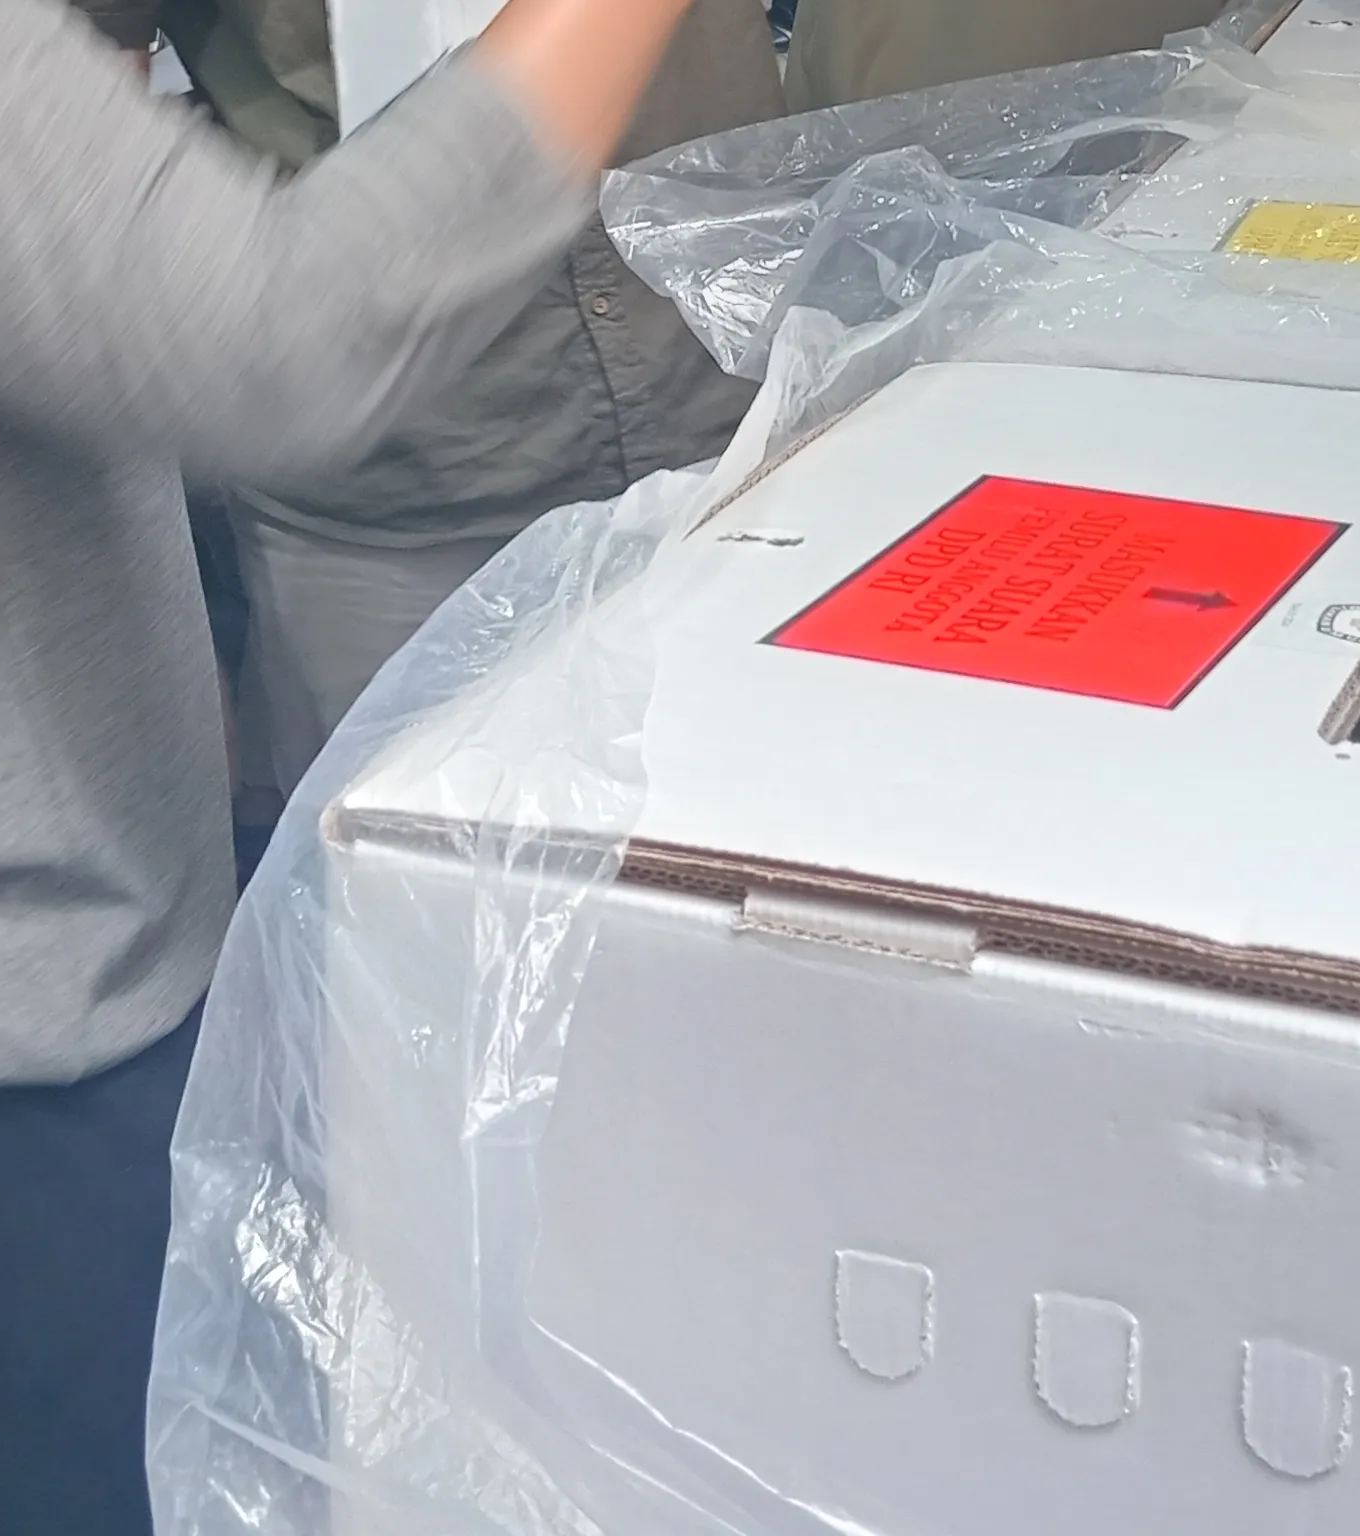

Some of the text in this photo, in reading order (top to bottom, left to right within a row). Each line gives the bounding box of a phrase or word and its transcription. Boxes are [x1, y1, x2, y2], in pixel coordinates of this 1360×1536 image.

[864, 526, 989, 594] DPD RI
[880, 558, 1004, 635] ANGGOTA
[930, 509, 1133, 649] SURAT SUARA
[1018, 532, 1181, 643] MASUKKAN
